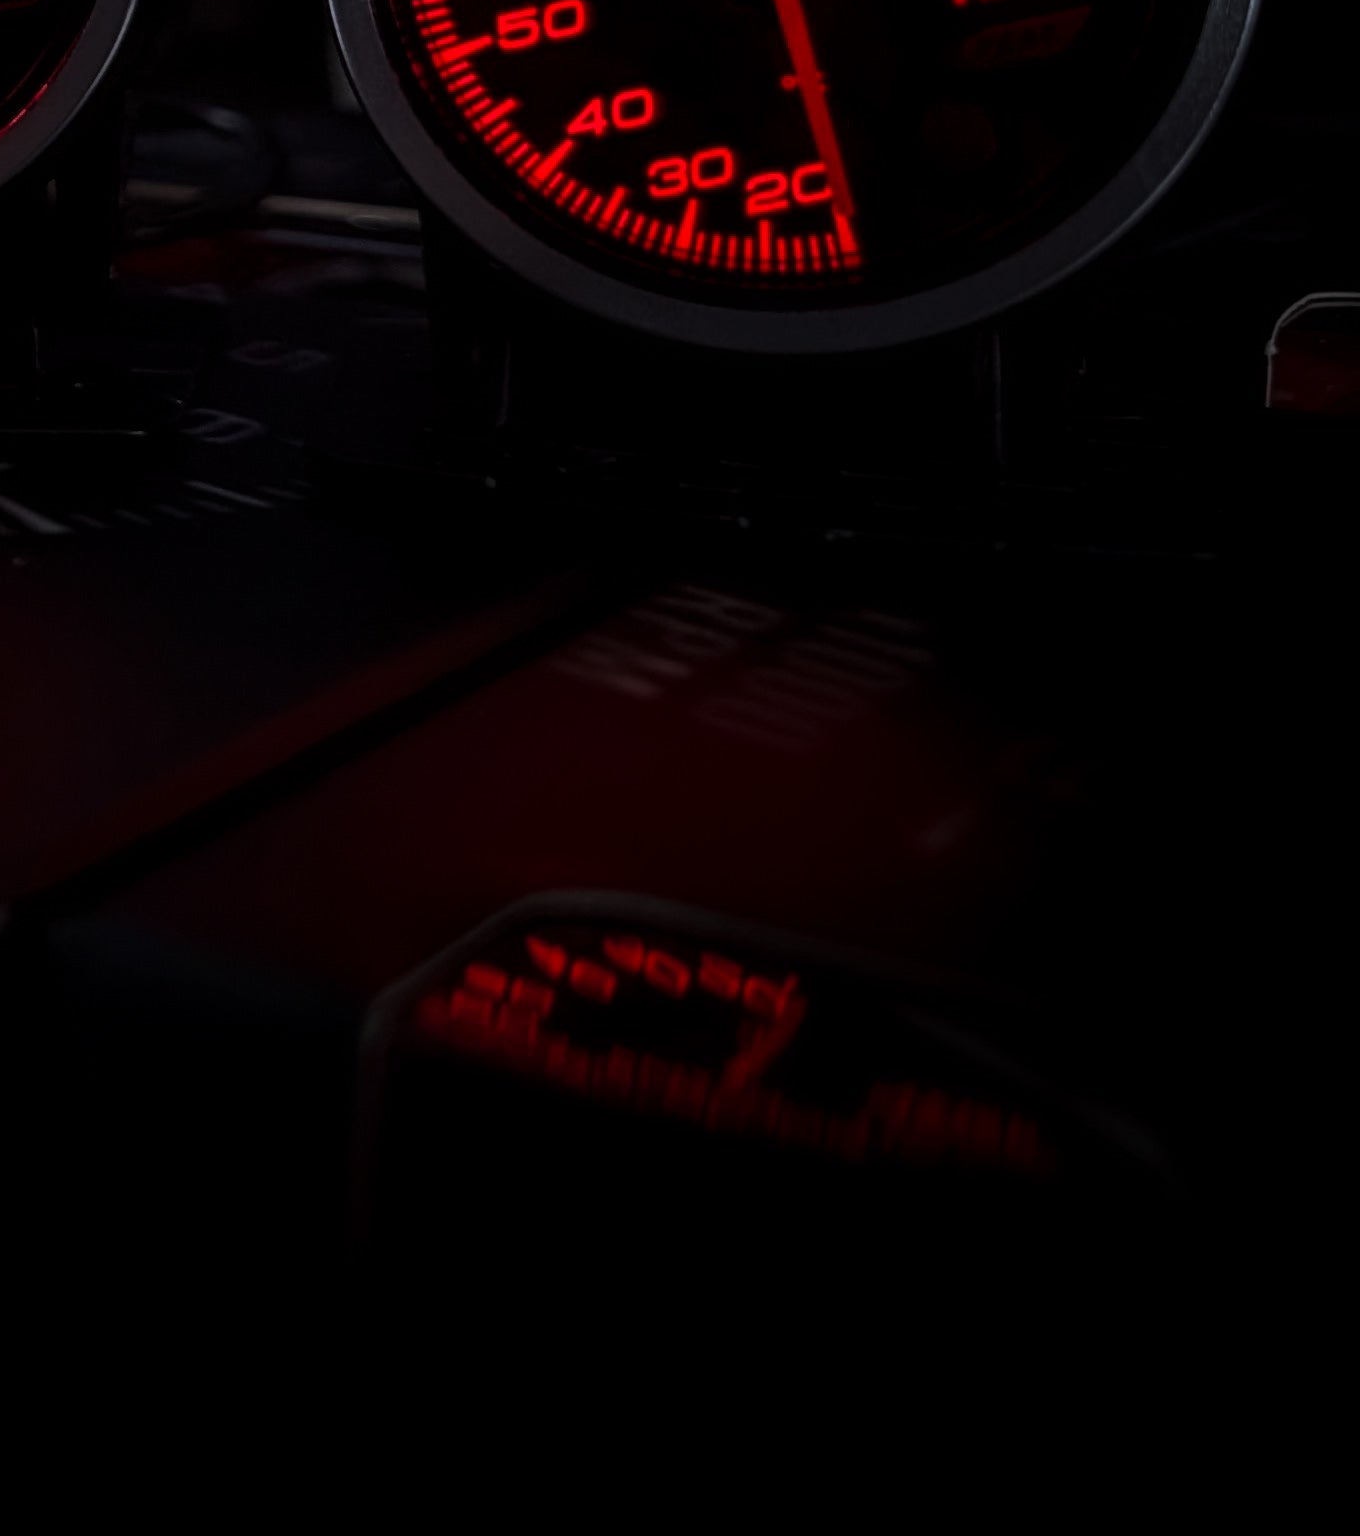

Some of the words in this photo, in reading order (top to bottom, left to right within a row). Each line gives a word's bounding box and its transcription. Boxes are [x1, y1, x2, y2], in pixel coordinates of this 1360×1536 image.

[566, 87, 662, 138] 40
[645, 147, 737, 199] 30
[744, 162, 833, 214] 20
